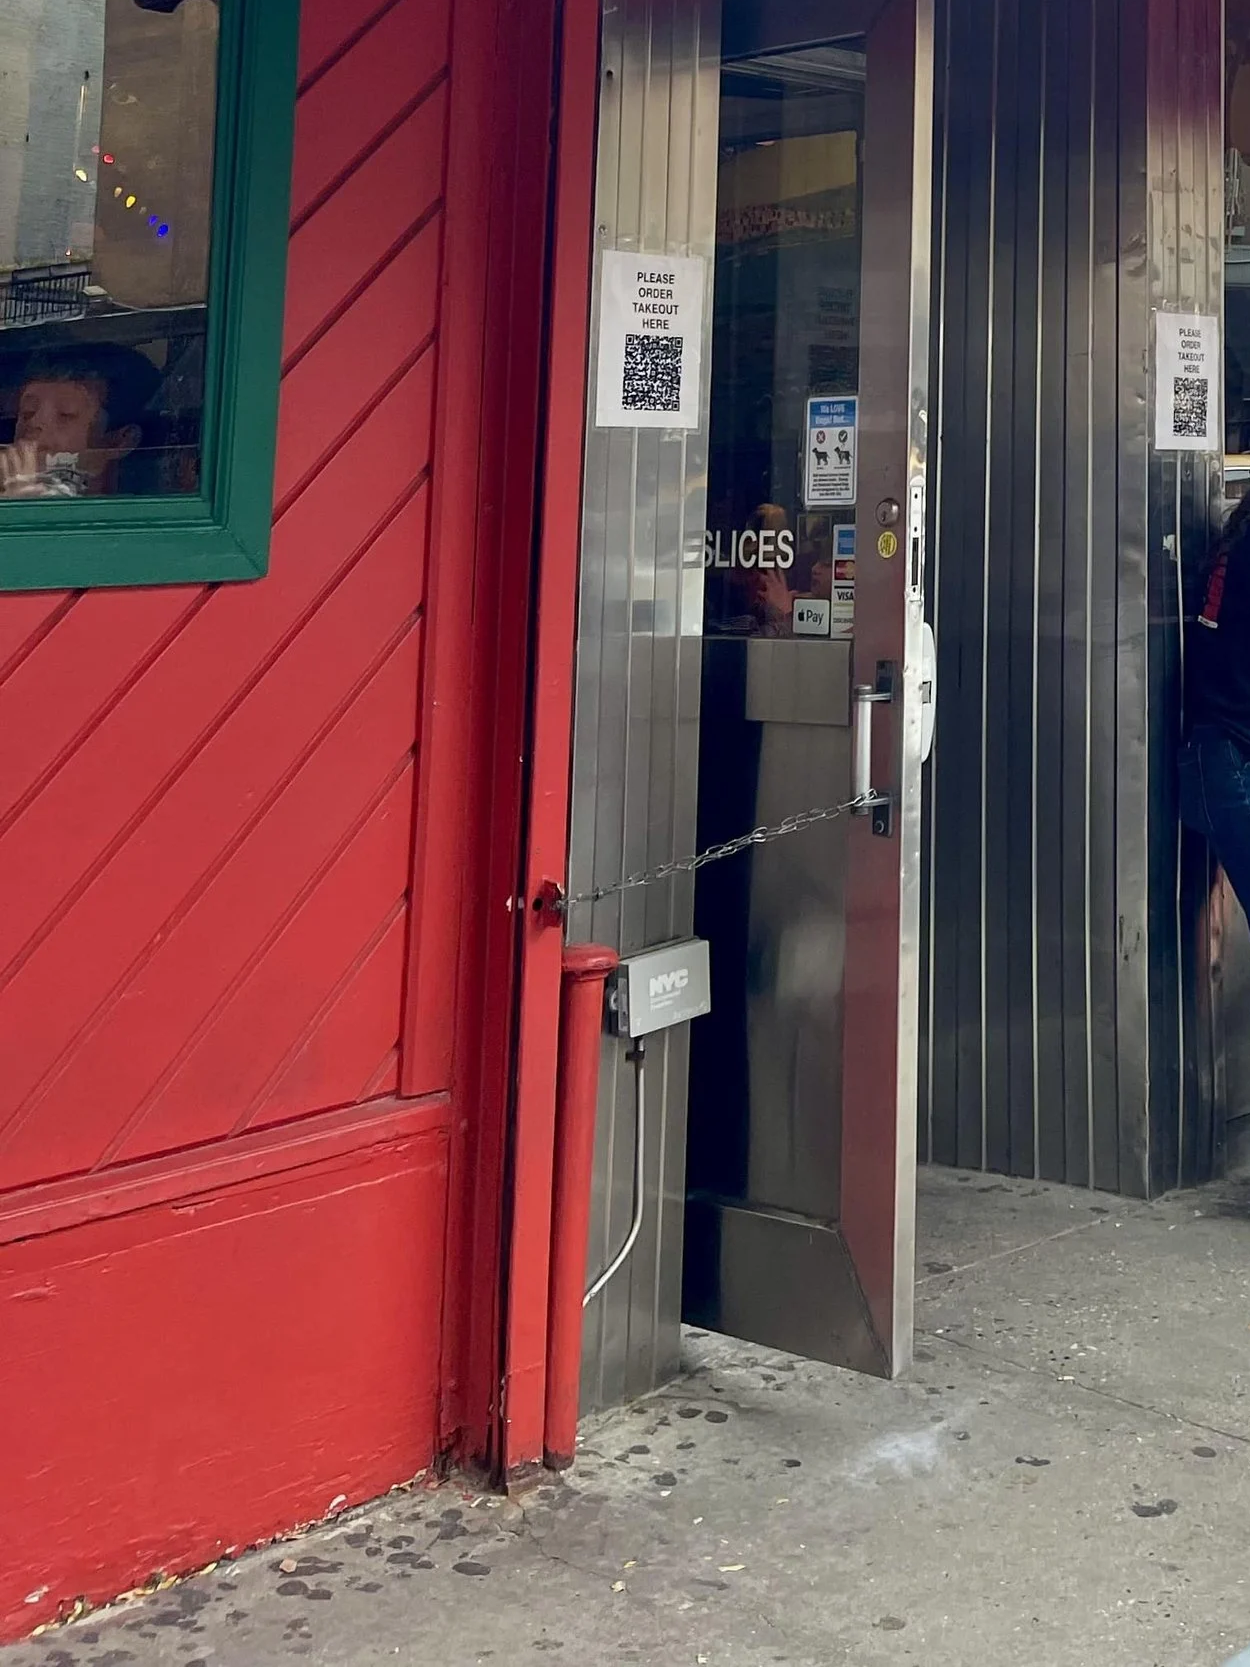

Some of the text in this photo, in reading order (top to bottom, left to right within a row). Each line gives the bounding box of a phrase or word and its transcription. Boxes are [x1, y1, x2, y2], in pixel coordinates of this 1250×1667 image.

[637, 271, 675, 285] PLEASE
[638, 287, 673, 300] ORDER
[632, 302, 679, 316] TAKEOUT
[642, 318, 670, 331] HERE
[1179, 328, 1202, 338] PLEASE
[1181, 339, 1201, 349] ORDER
[1178, 351, 1205, 362] TAKEOUT
[1184, 364, 1200, 374] HERE
[705, 529, 795, 569] SLICES
[837, 591, 854, 601] VISA
[806, 609, 824, 626] Pay
[650, 968, 689, 996] NYC
